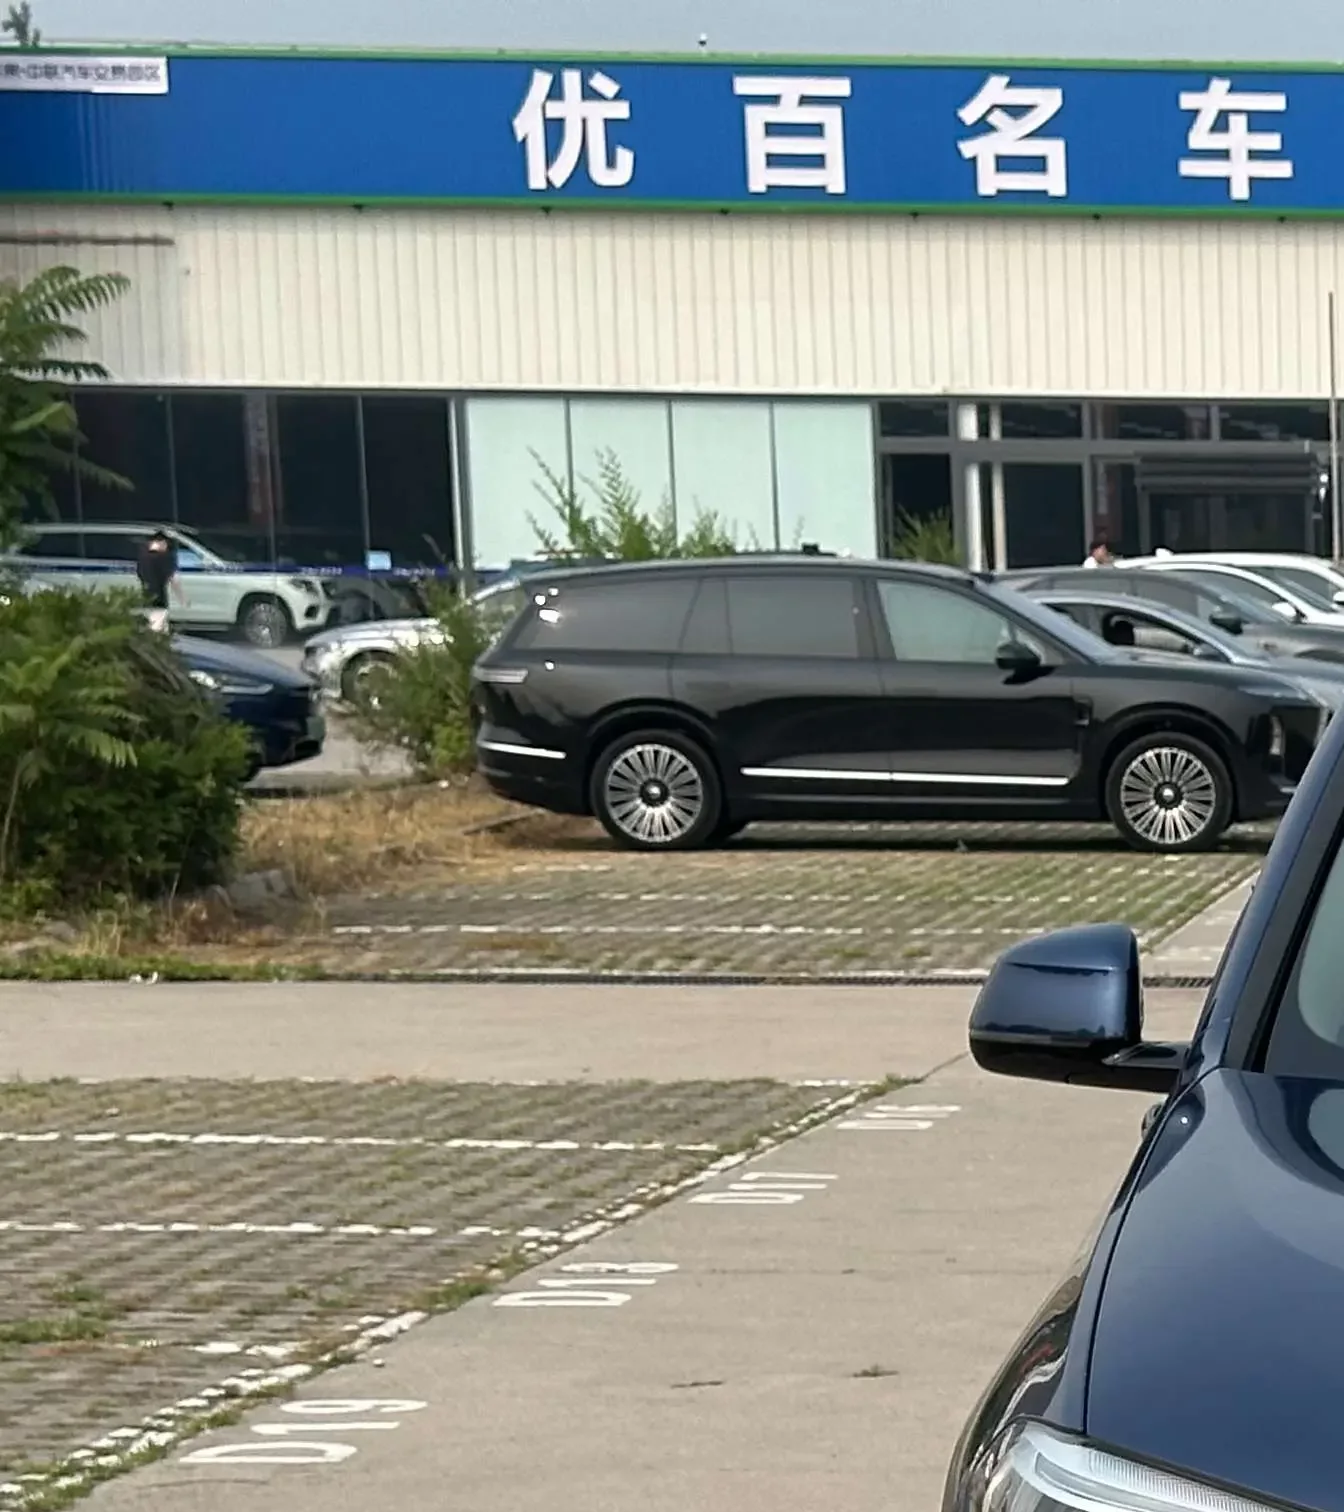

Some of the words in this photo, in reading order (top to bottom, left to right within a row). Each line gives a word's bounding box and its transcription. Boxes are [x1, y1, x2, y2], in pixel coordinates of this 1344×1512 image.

[512, 68, 1293, 201] 优百名车
[688, 1171, 839, 1204] D17
[492, 1261, 680, 1307] D18
[179, 1398, 428, 1463] D19
